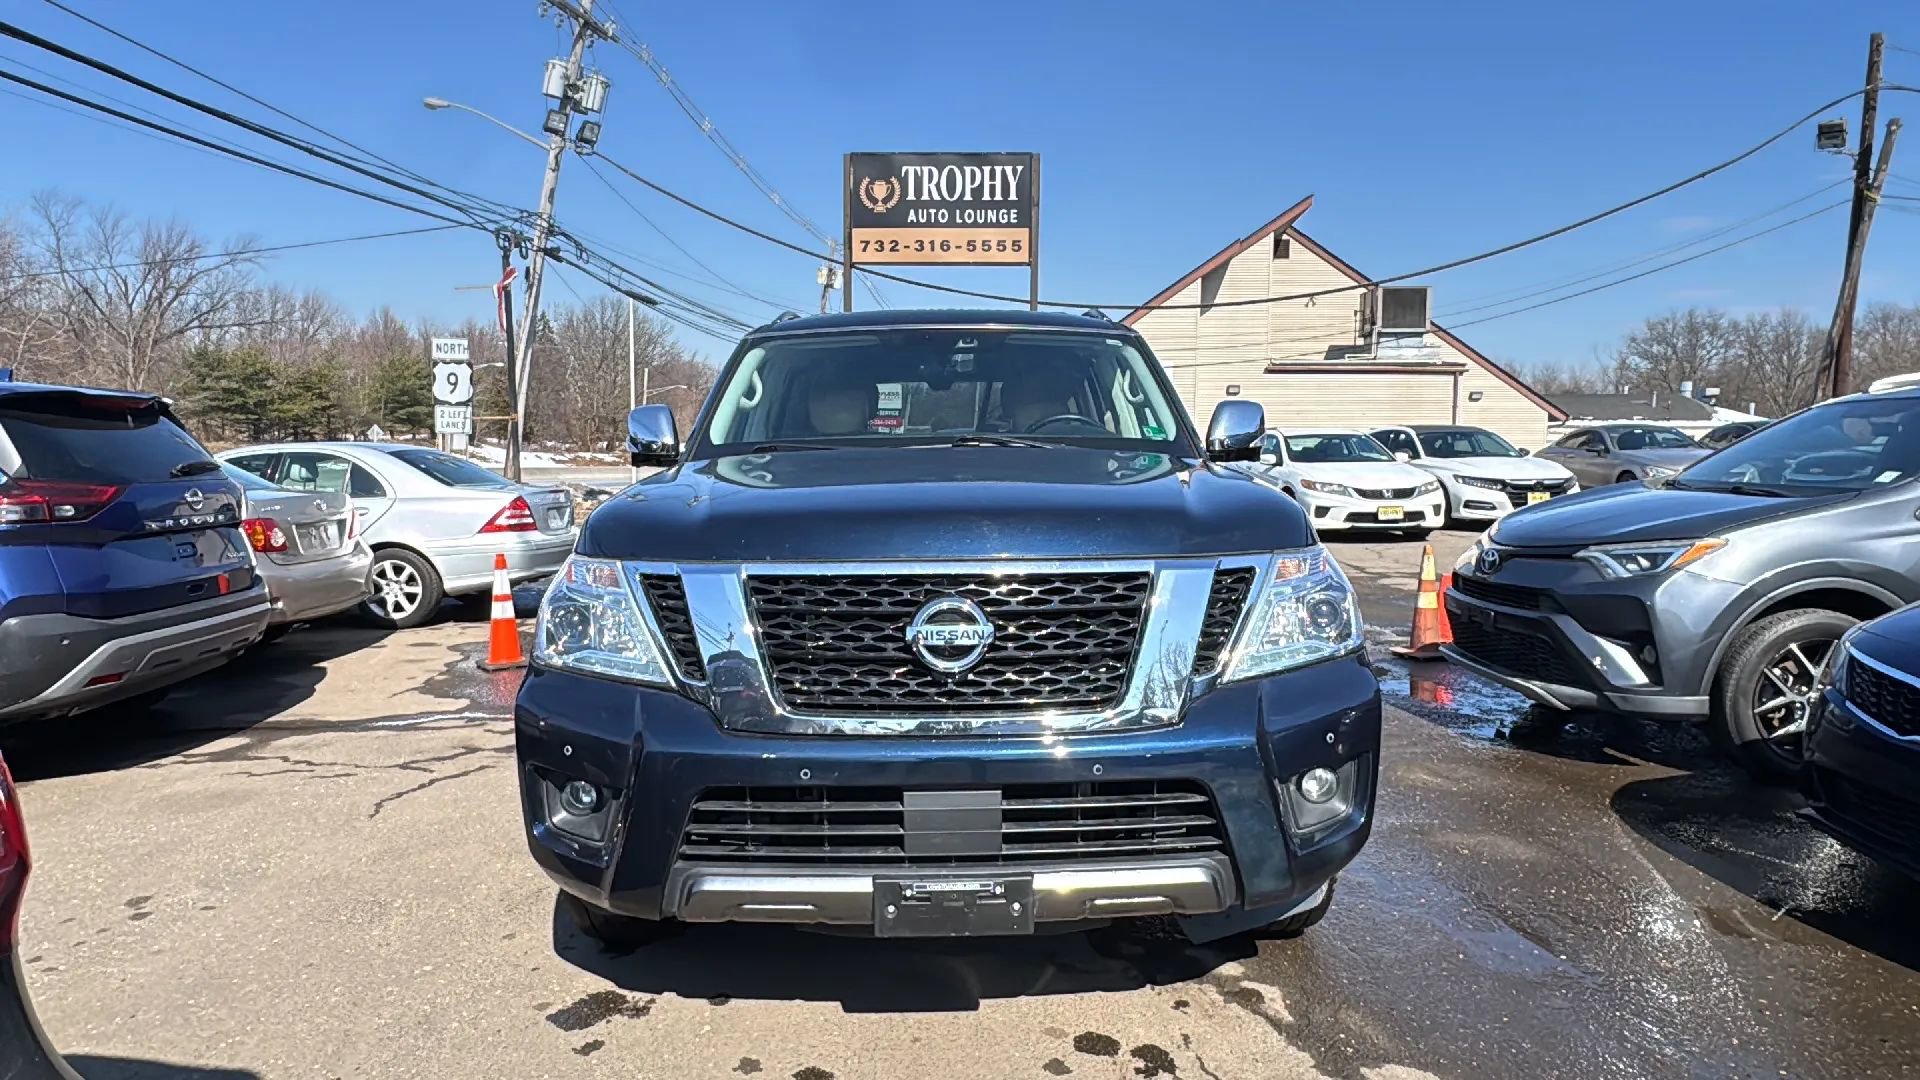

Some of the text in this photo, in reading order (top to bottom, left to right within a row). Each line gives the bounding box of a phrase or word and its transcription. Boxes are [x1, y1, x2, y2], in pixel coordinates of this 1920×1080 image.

[902, 165, 1024, 201] TROPHY
[907, 208, 1018, 223] AUTO LOUNGE
[860, 239, 1022, 253] 732-316-5555
[436, 343, 469, 354] NORTH
[447, 372, 459, 394] 9
[440, 410, 467, 418] 2 LEFT
[441, 421, 465, 429] LANES
[165, 514, 225, 527] ROGUE
[916, 630, 985, 641] NISSAN
